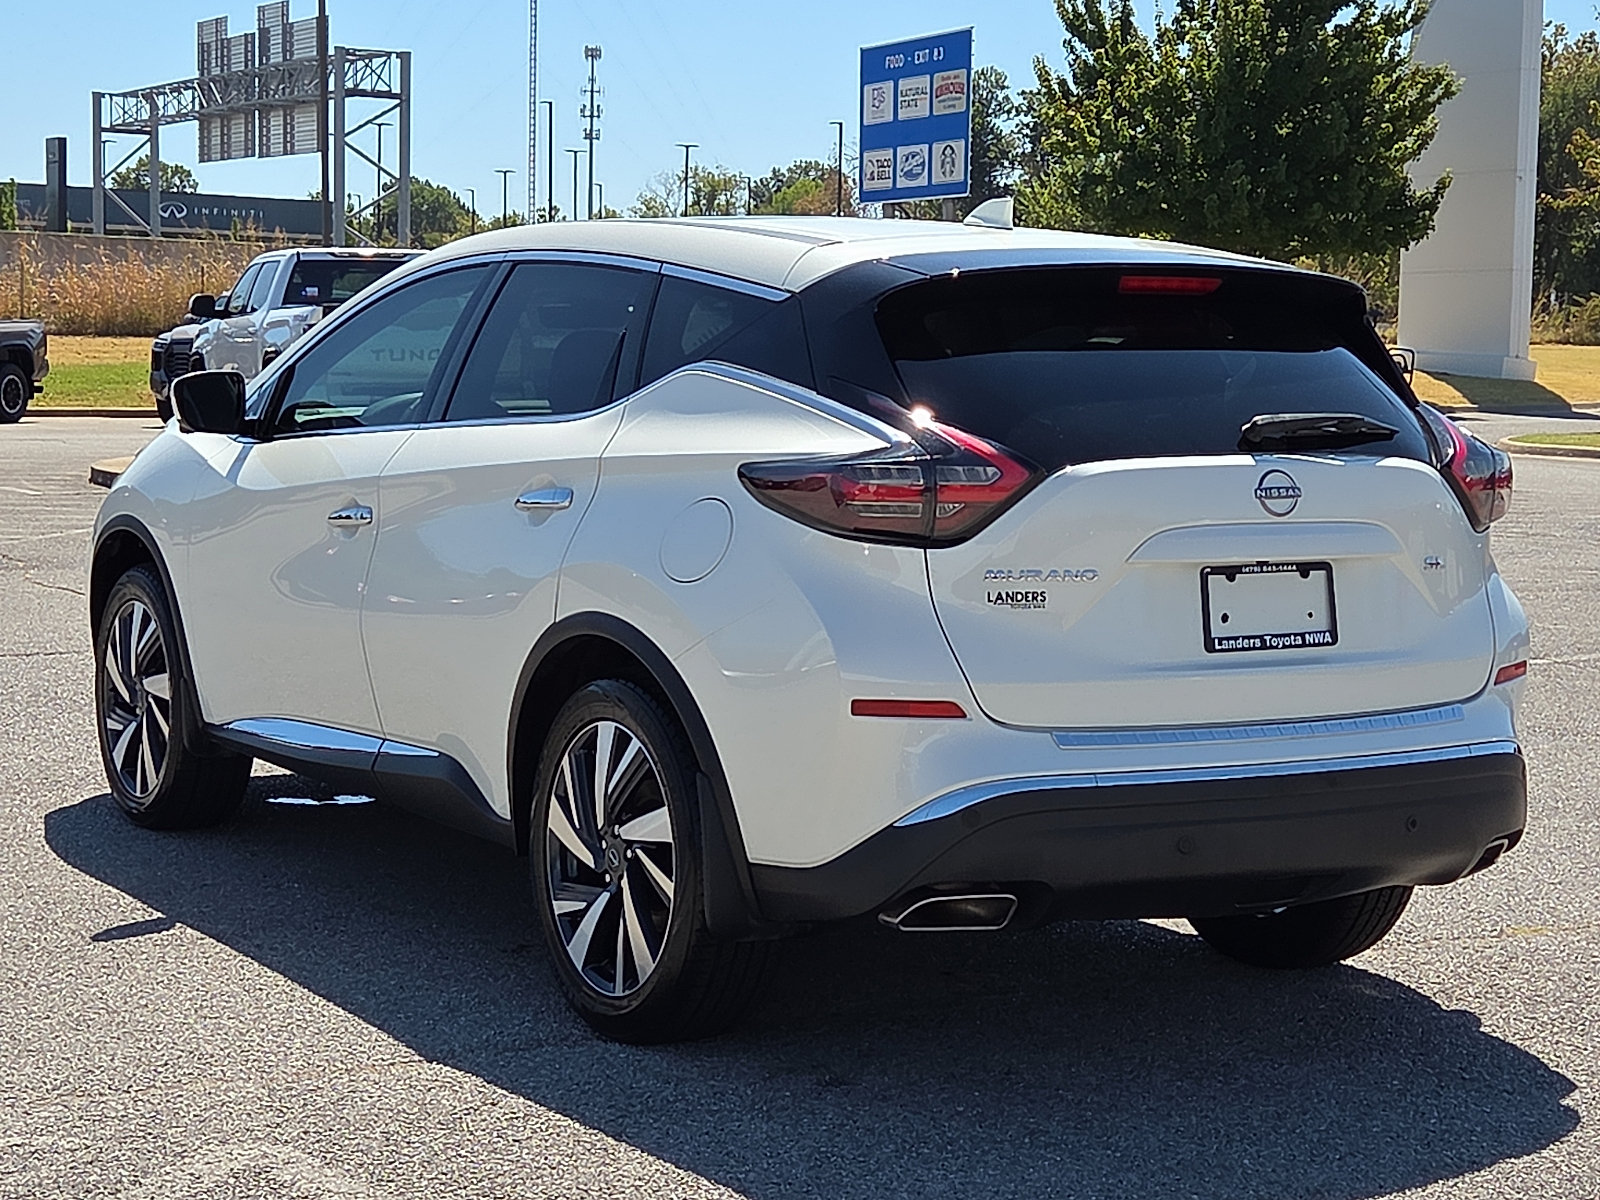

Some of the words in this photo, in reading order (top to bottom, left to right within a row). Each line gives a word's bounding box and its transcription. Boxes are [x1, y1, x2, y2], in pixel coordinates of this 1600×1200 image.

[885, 54, 905, 69] FOOD
[914, 48, 930, 64] EXIT
[900, 86, 928, 98] NATURAL
[900, 99, 918, 110] STATE
[876, 158, 891, 169] TACO
[876, 169, 891, 180] BELL
[194, 206, 264, 218] INFINITI
[1256, 488, 1301, 498] NISSAN
[983, 569, 1099, 582] MURANO
[986, 590, 1047, 605] LANDERS
[1214, 637, 1261, 650] Landers
[1263, 635, 1302, 648] Toyota
[1305, 632, 1332, 645] NWA
